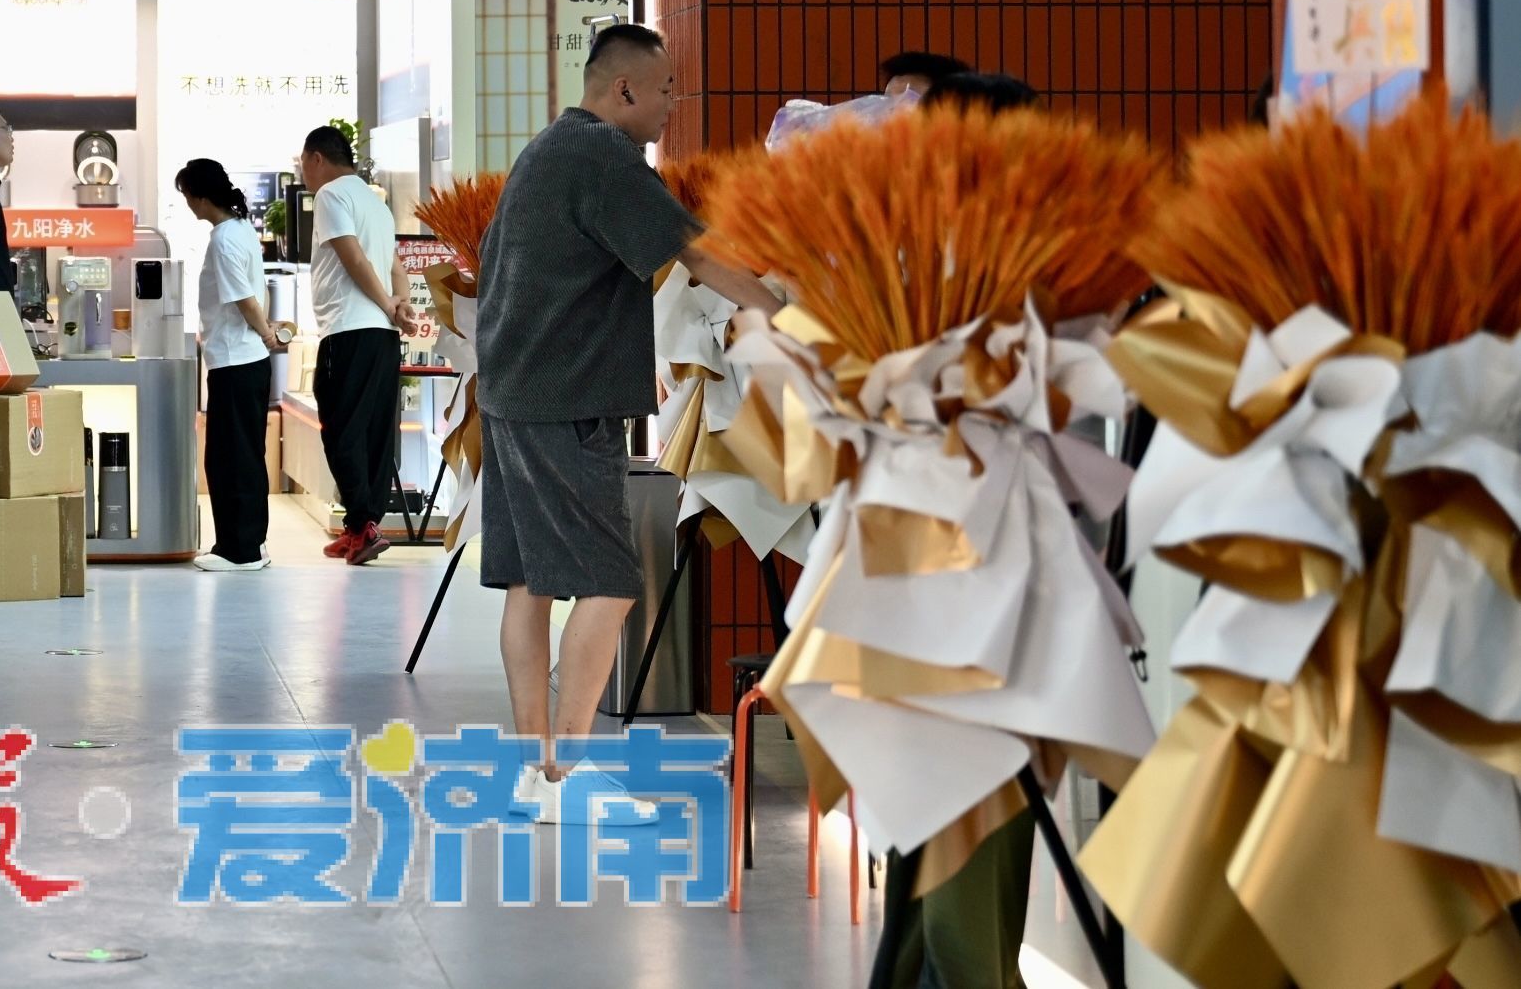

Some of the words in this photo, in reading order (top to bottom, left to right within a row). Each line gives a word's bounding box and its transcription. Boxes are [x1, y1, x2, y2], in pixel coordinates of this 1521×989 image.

[180, 74, 350, 96] 不想洗就不用洗
[12, 217, 95, 239] 九阳净水
